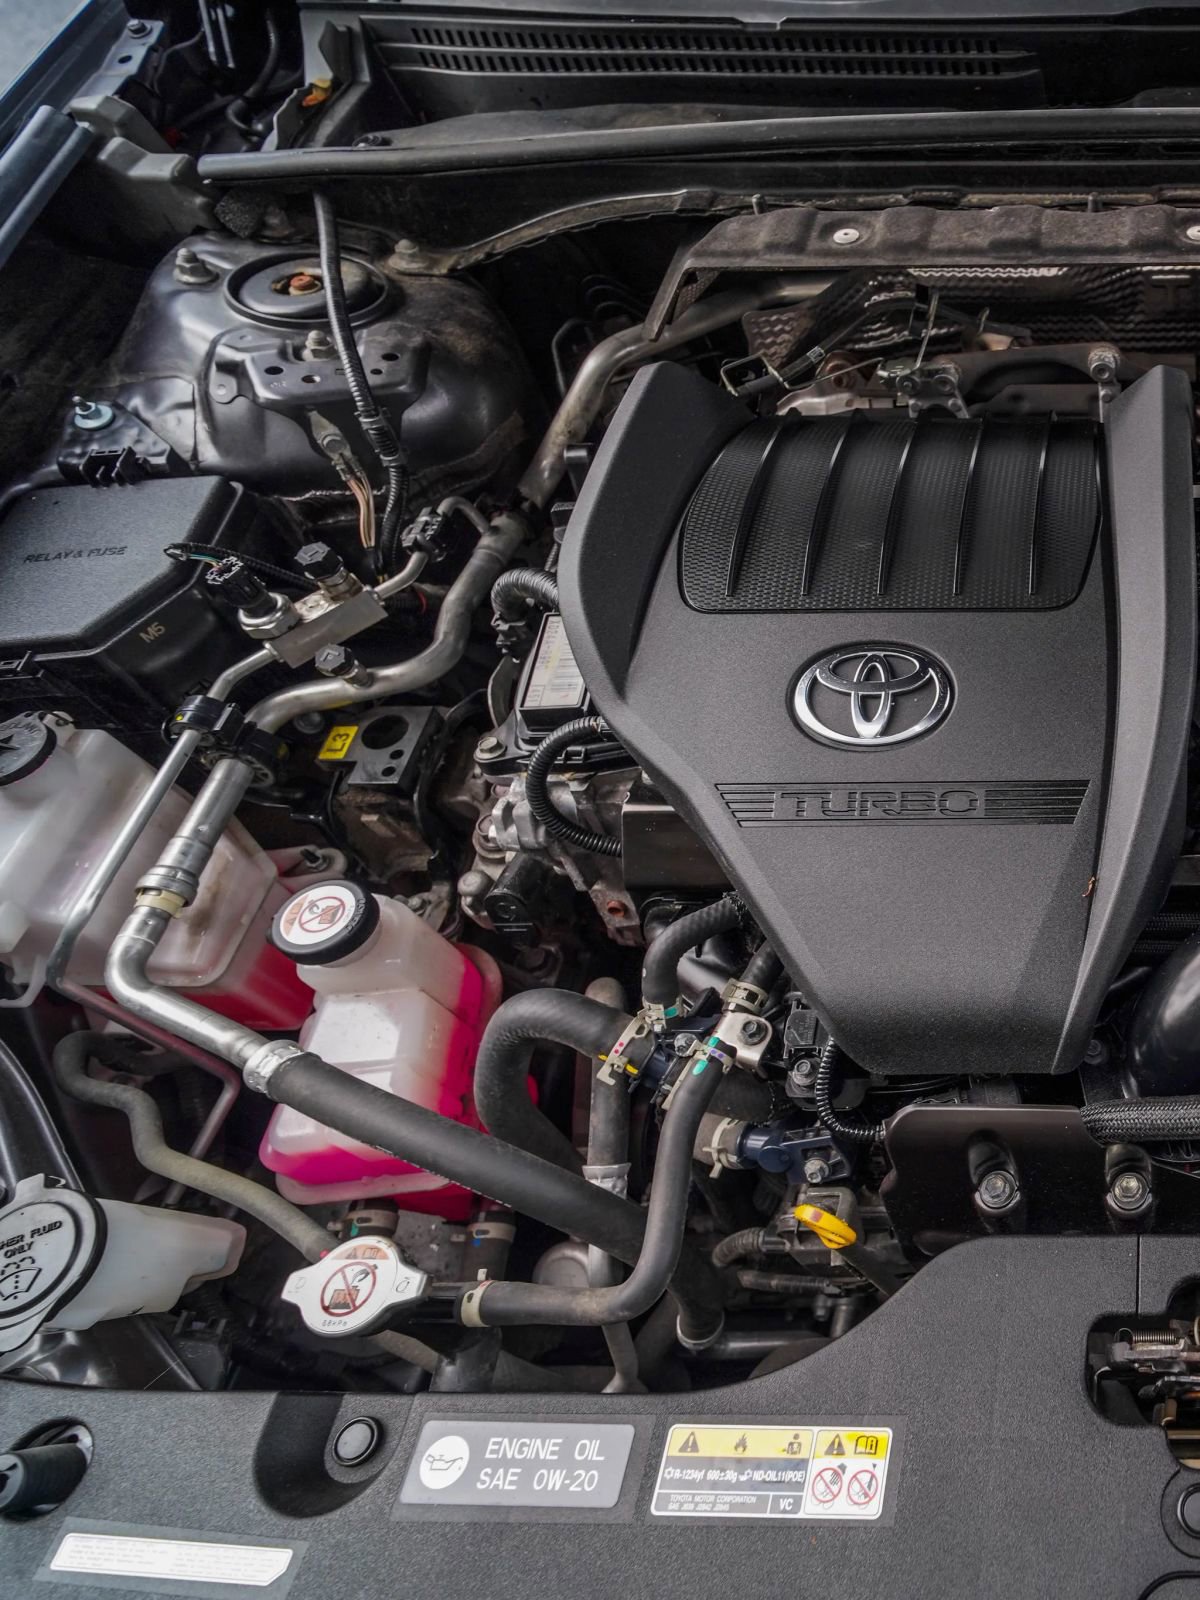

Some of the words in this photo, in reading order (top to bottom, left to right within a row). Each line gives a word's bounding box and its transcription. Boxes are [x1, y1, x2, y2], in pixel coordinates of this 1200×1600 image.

[87, 546, 128, 558] FUSE
[326, 732, 351, 753] L3
[780, 789, 980, 818] TURBO
[30, 1220, 63, 1239] FLUID
[4, 1241, 35, 1259] ONLY
[484, 1437, 563, 1460] ENGINE
[574, 1439, 605, 1461] OIL
[476, 1467, 522, 1490] SAE
[533, 1469, 599, 1492] 0W-20
[669, 1494, 692, 1503] TOYOTA
[694, 1494, 715, 1503] MOTOR
[716, 1495, 757, 1504] CORPORATION
[779, 1497, 794, 1511] VC
